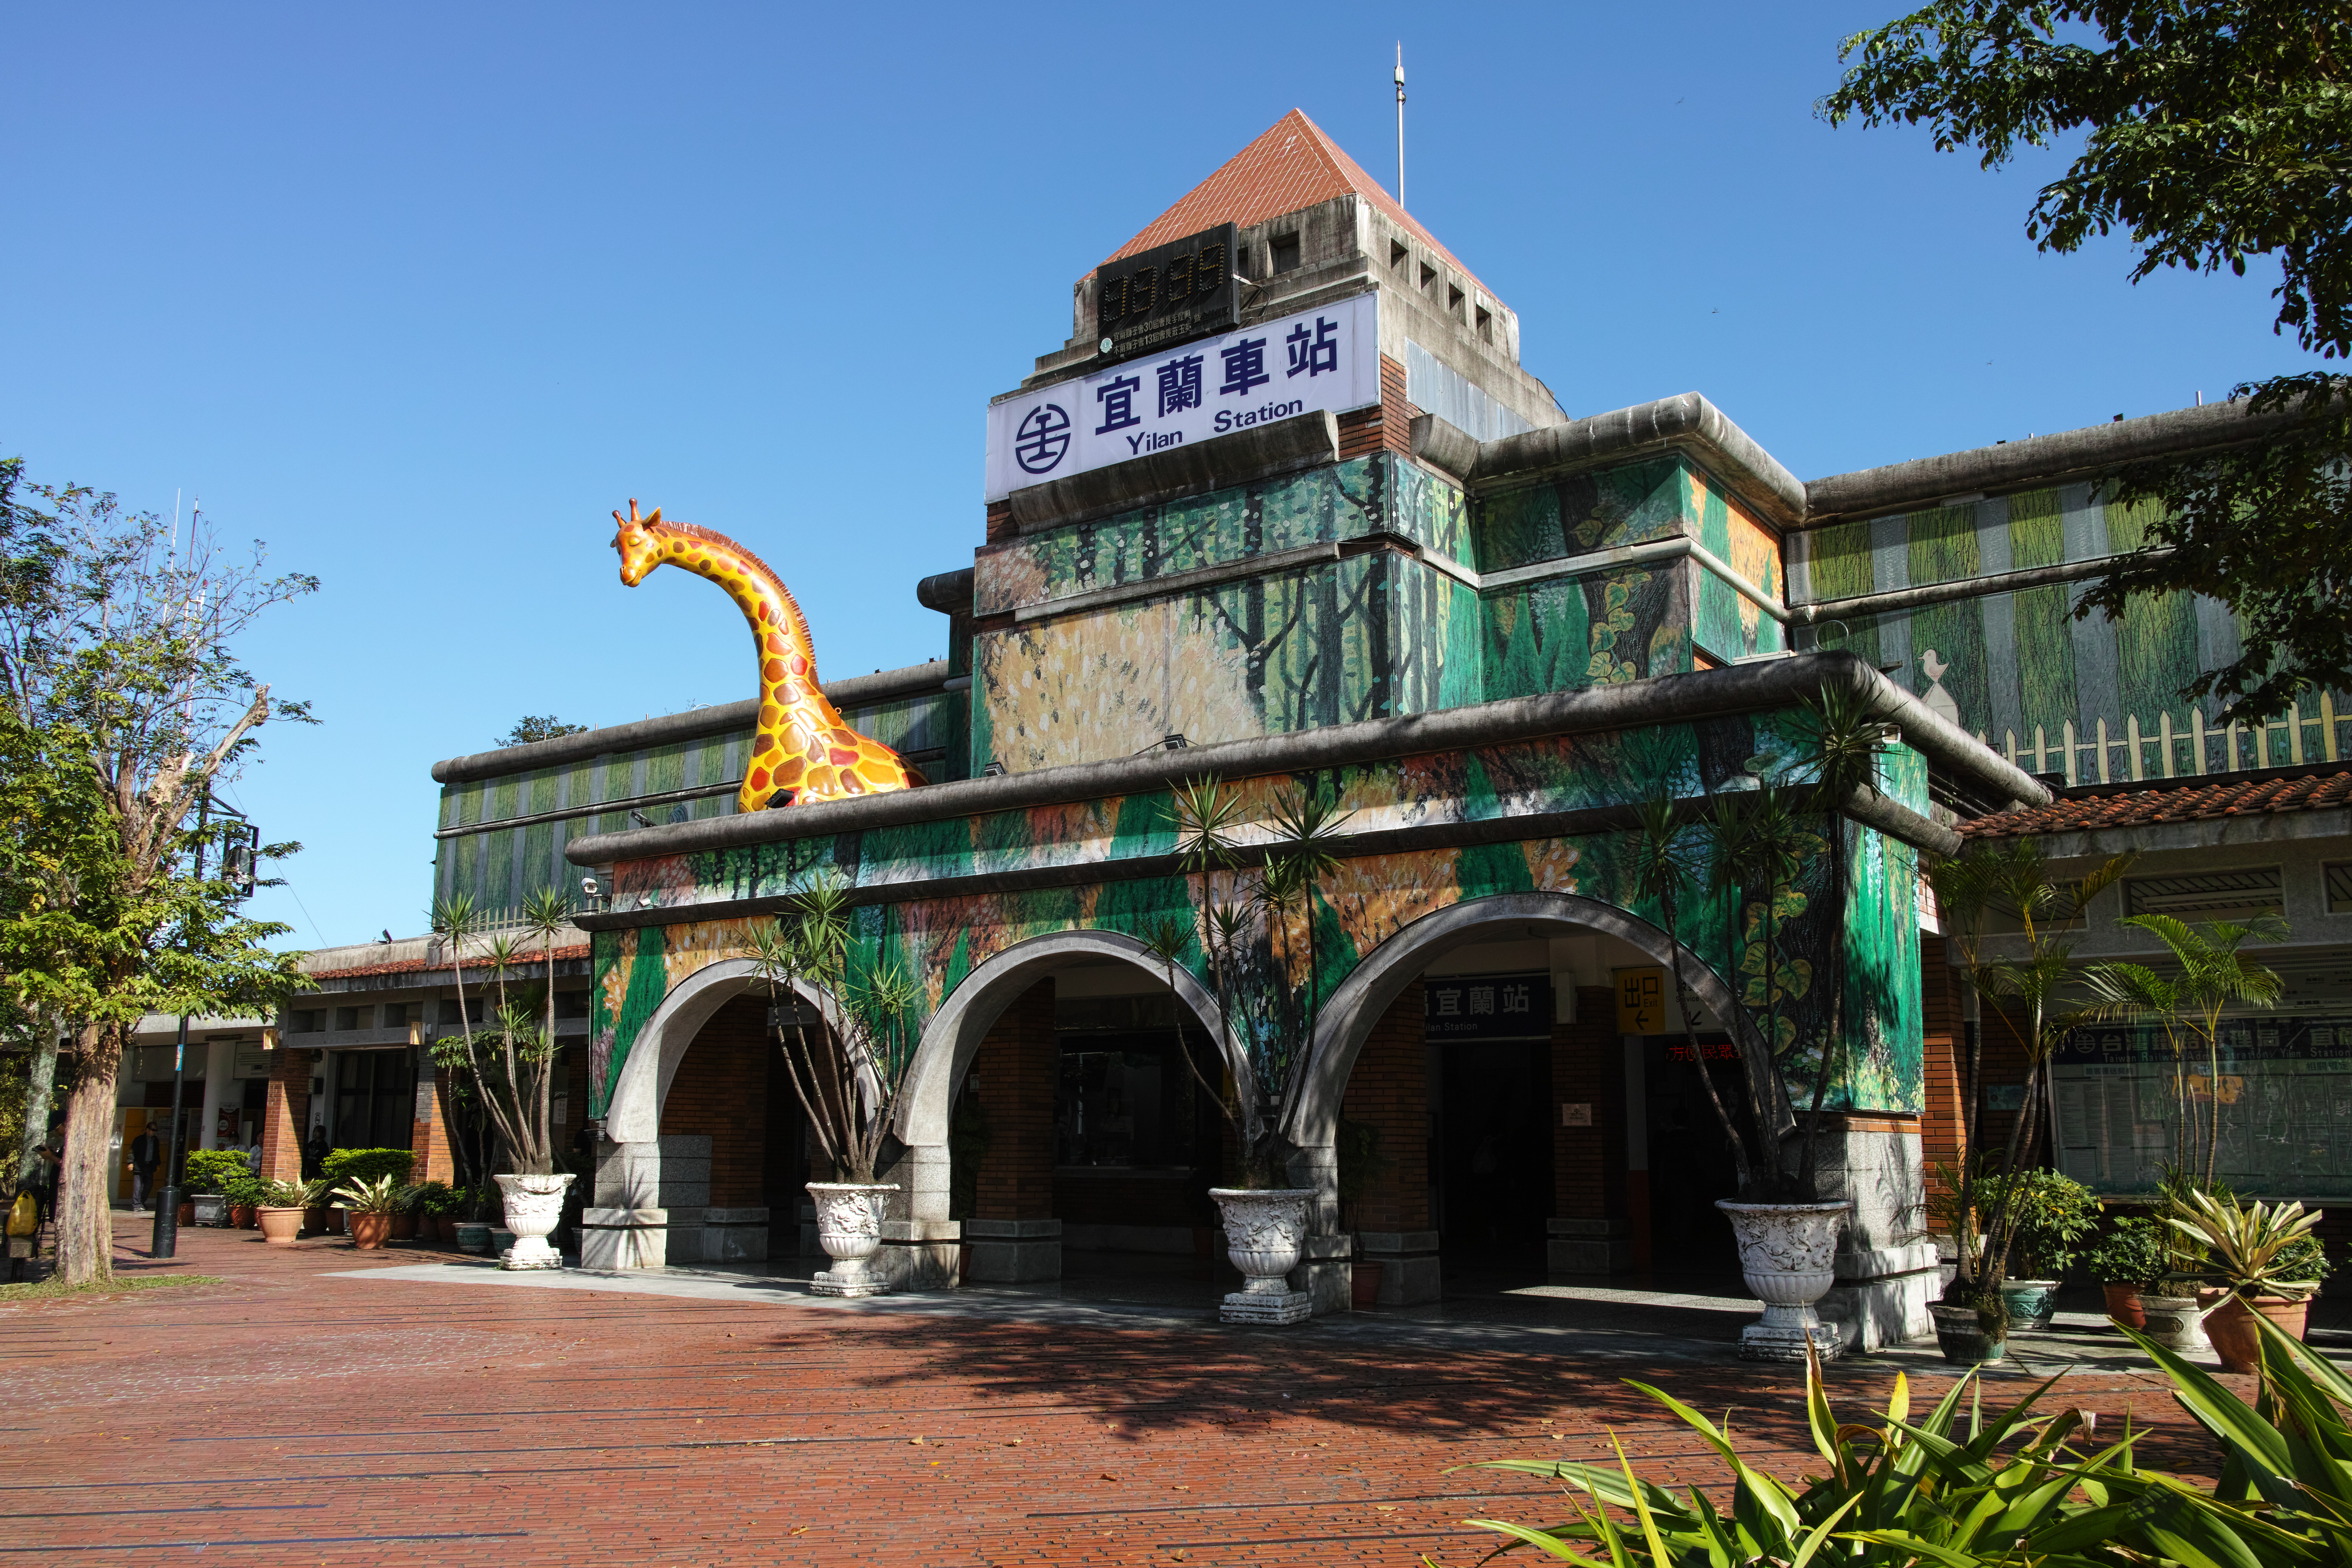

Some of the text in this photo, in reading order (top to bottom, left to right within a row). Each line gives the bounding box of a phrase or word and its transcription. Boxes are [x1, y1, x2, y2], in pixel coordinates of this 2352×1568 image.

[1096, 316, 1338, 435] 宜蘭車站
[1126, 398, 1303, 455] Yilan Station
[1624, 976, 1658, 1008] 出口
[1644, 998, 1658, 1008] Exit
[1424, 1022, 1478, 1032] ilan Station
[2103, 1052, 2136, 1064] Taiwan
[2142, 1051, 2184, 1062] Railwas
[2188, 1048, 2268, 1062] Admnistration
[2310, 1047, 2351, 1058] Station
[2306, 1061, 2350, 1072] 相關規定
